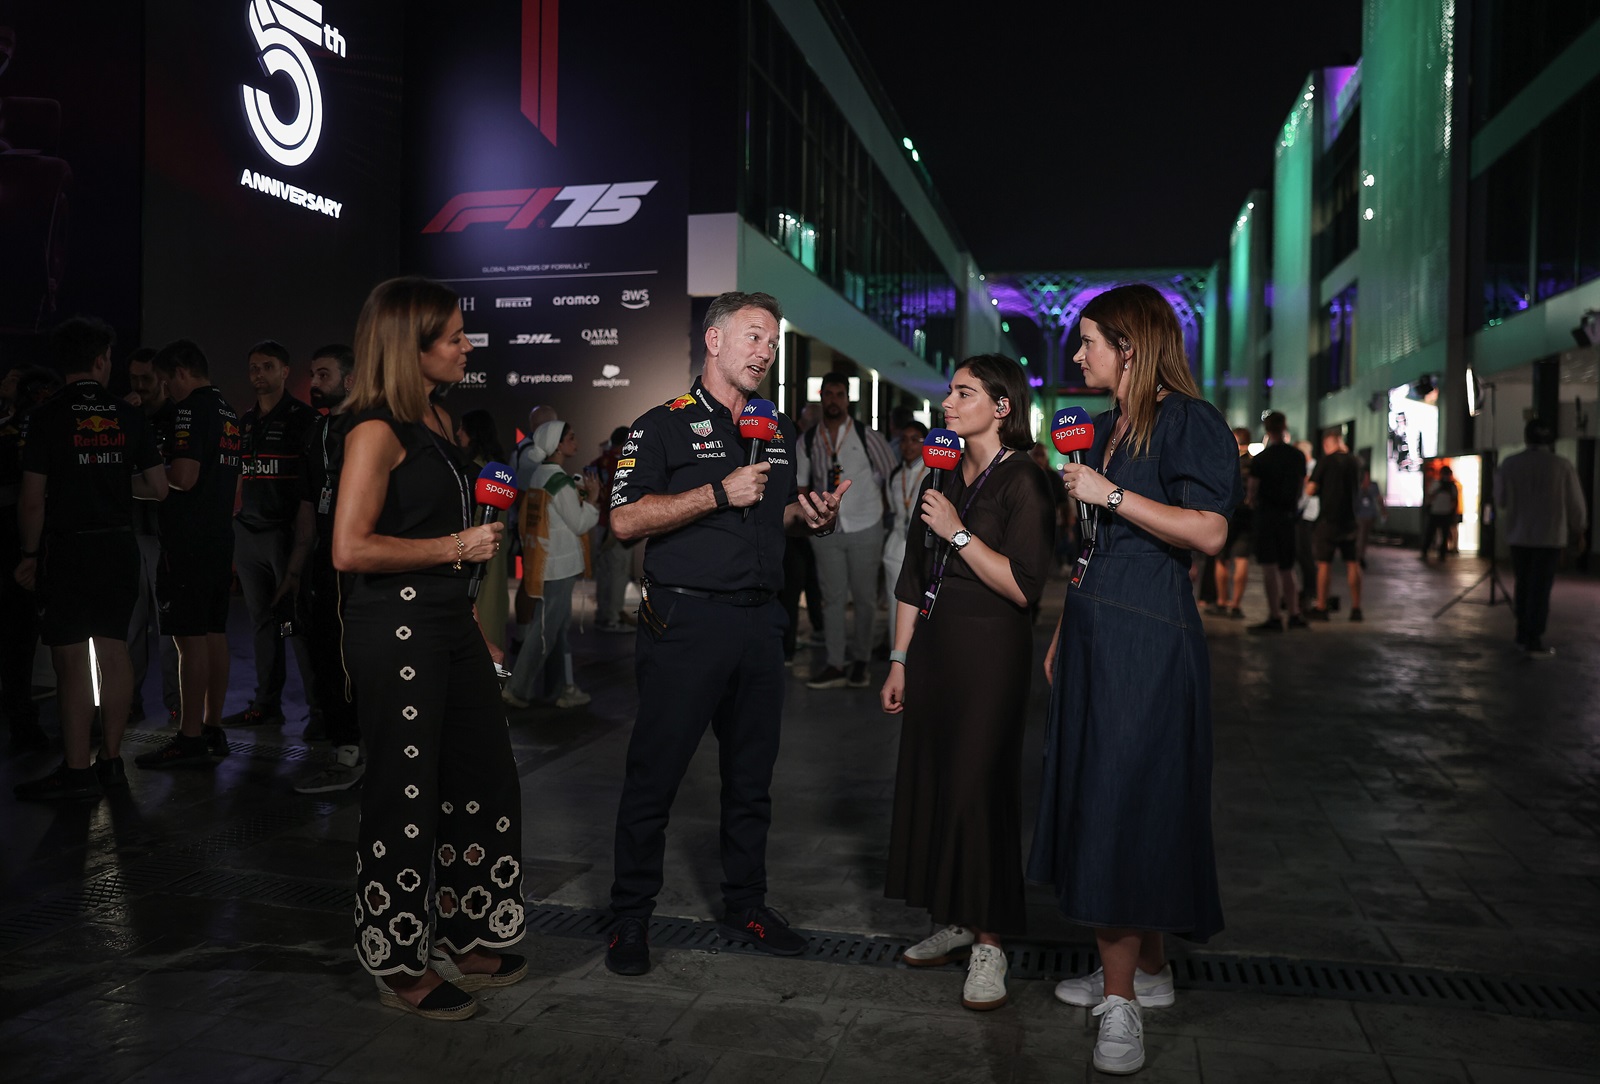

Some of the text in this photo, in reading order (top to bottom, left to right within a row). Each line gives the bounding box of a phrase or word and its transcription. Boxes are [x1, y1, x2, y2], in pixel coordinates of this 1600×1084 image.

[240, 168, 343, 219] ANNIVERSARY
[552, 295, 600, 306] aramco
[621, 289, 650, 302] aws
[495, 297, 532, 308] PIRELLI
[516, 333, 553, 345] DHL
[581, 328, 618, 342] QATAR
[520, 374, 573, 385] crypto.com
[592, 378, 630, 389] salesforce
[71, 404, 117, 412] ORACLE
[744, 404, 758, 414] sky
[739, 418, 759, 427] sports
[1058, 414, 1077, 425] sky
[1055, 427, 1086, 440] sports
[692, 441, 715, 450] Mobil
[935, 435, 952, 447] sky
[79, 452, 110, 465] Mobil
[696, 451, 727, 459] ORACLE
[928, 448, 956, 459] sports
[494, 470, 513, 484] sky
[485, 483, 515, 499] sports
